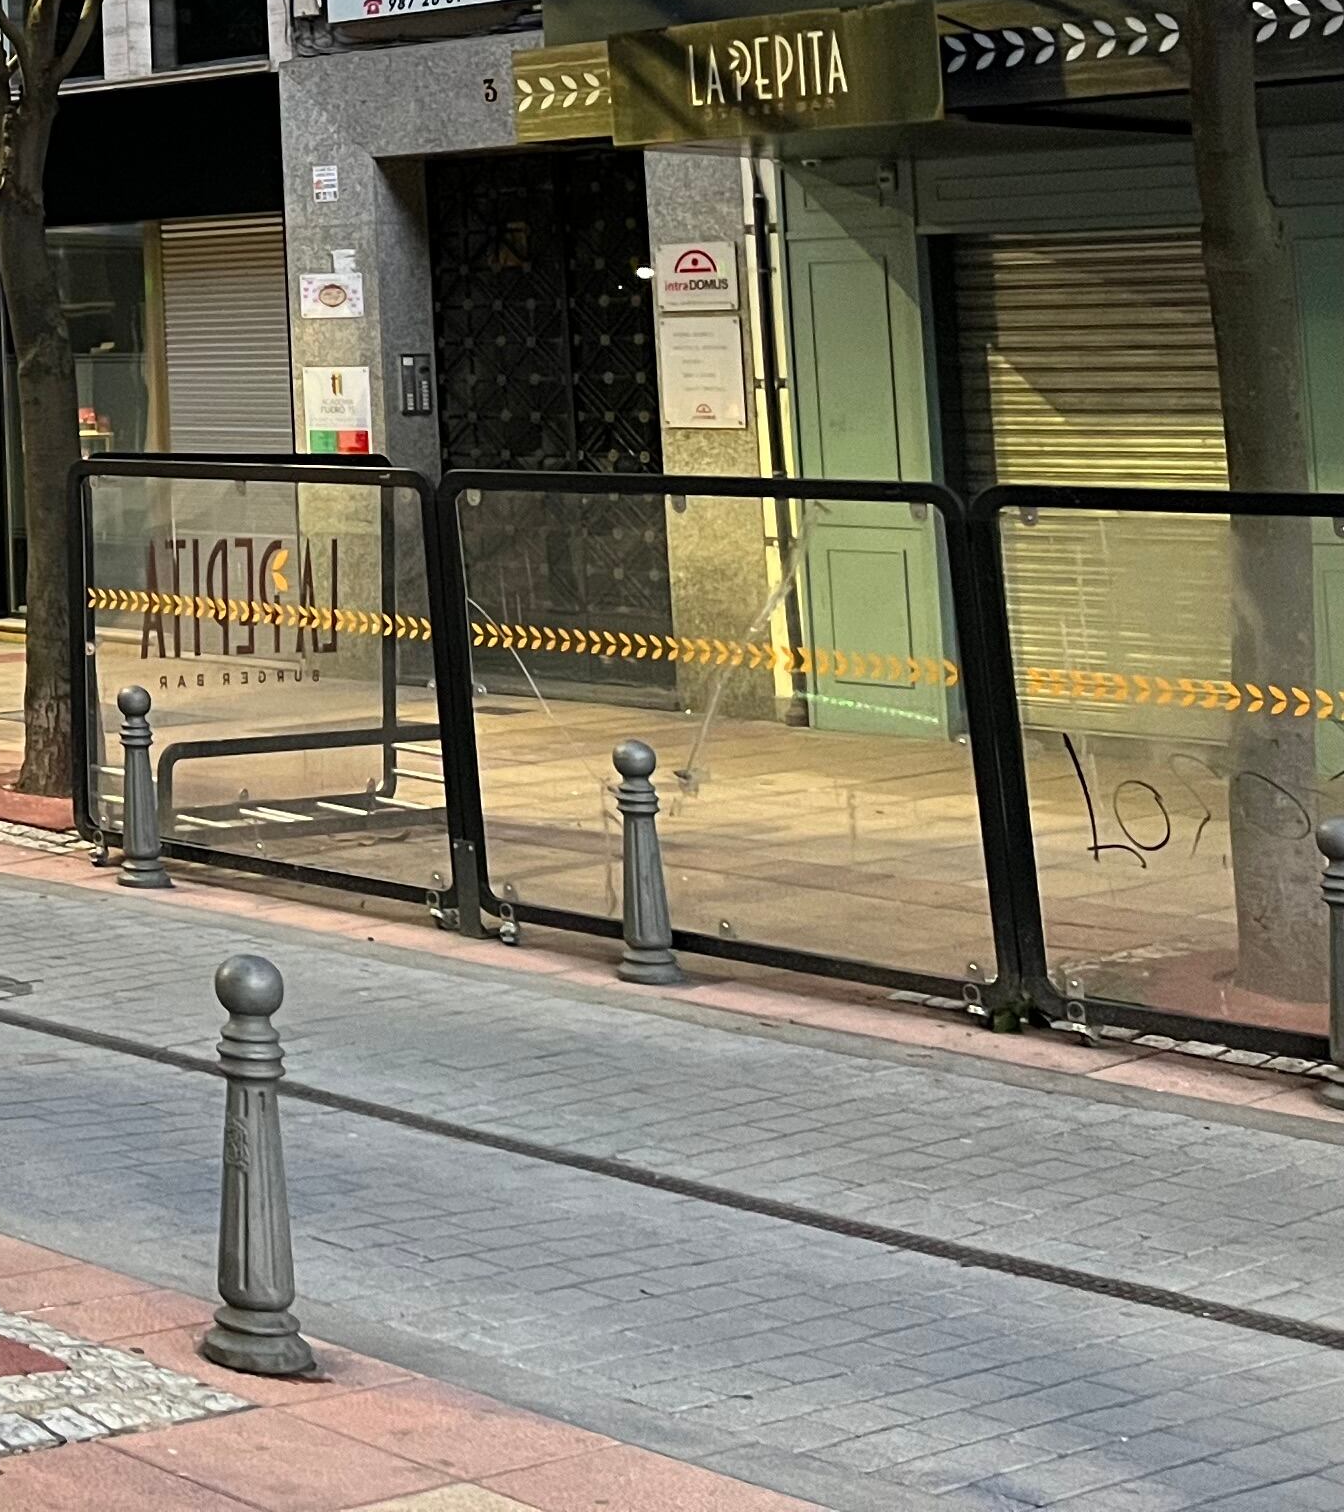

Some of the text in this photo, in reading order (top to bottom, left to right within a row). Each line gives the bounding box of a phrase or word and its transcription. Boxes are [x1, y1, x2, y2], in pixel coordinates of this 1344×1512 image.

[688, 29, 849, 106] LA PEPITA
[483, 78, 498, 103] 3
[664, 278, 729, 292] intraDOMUS
